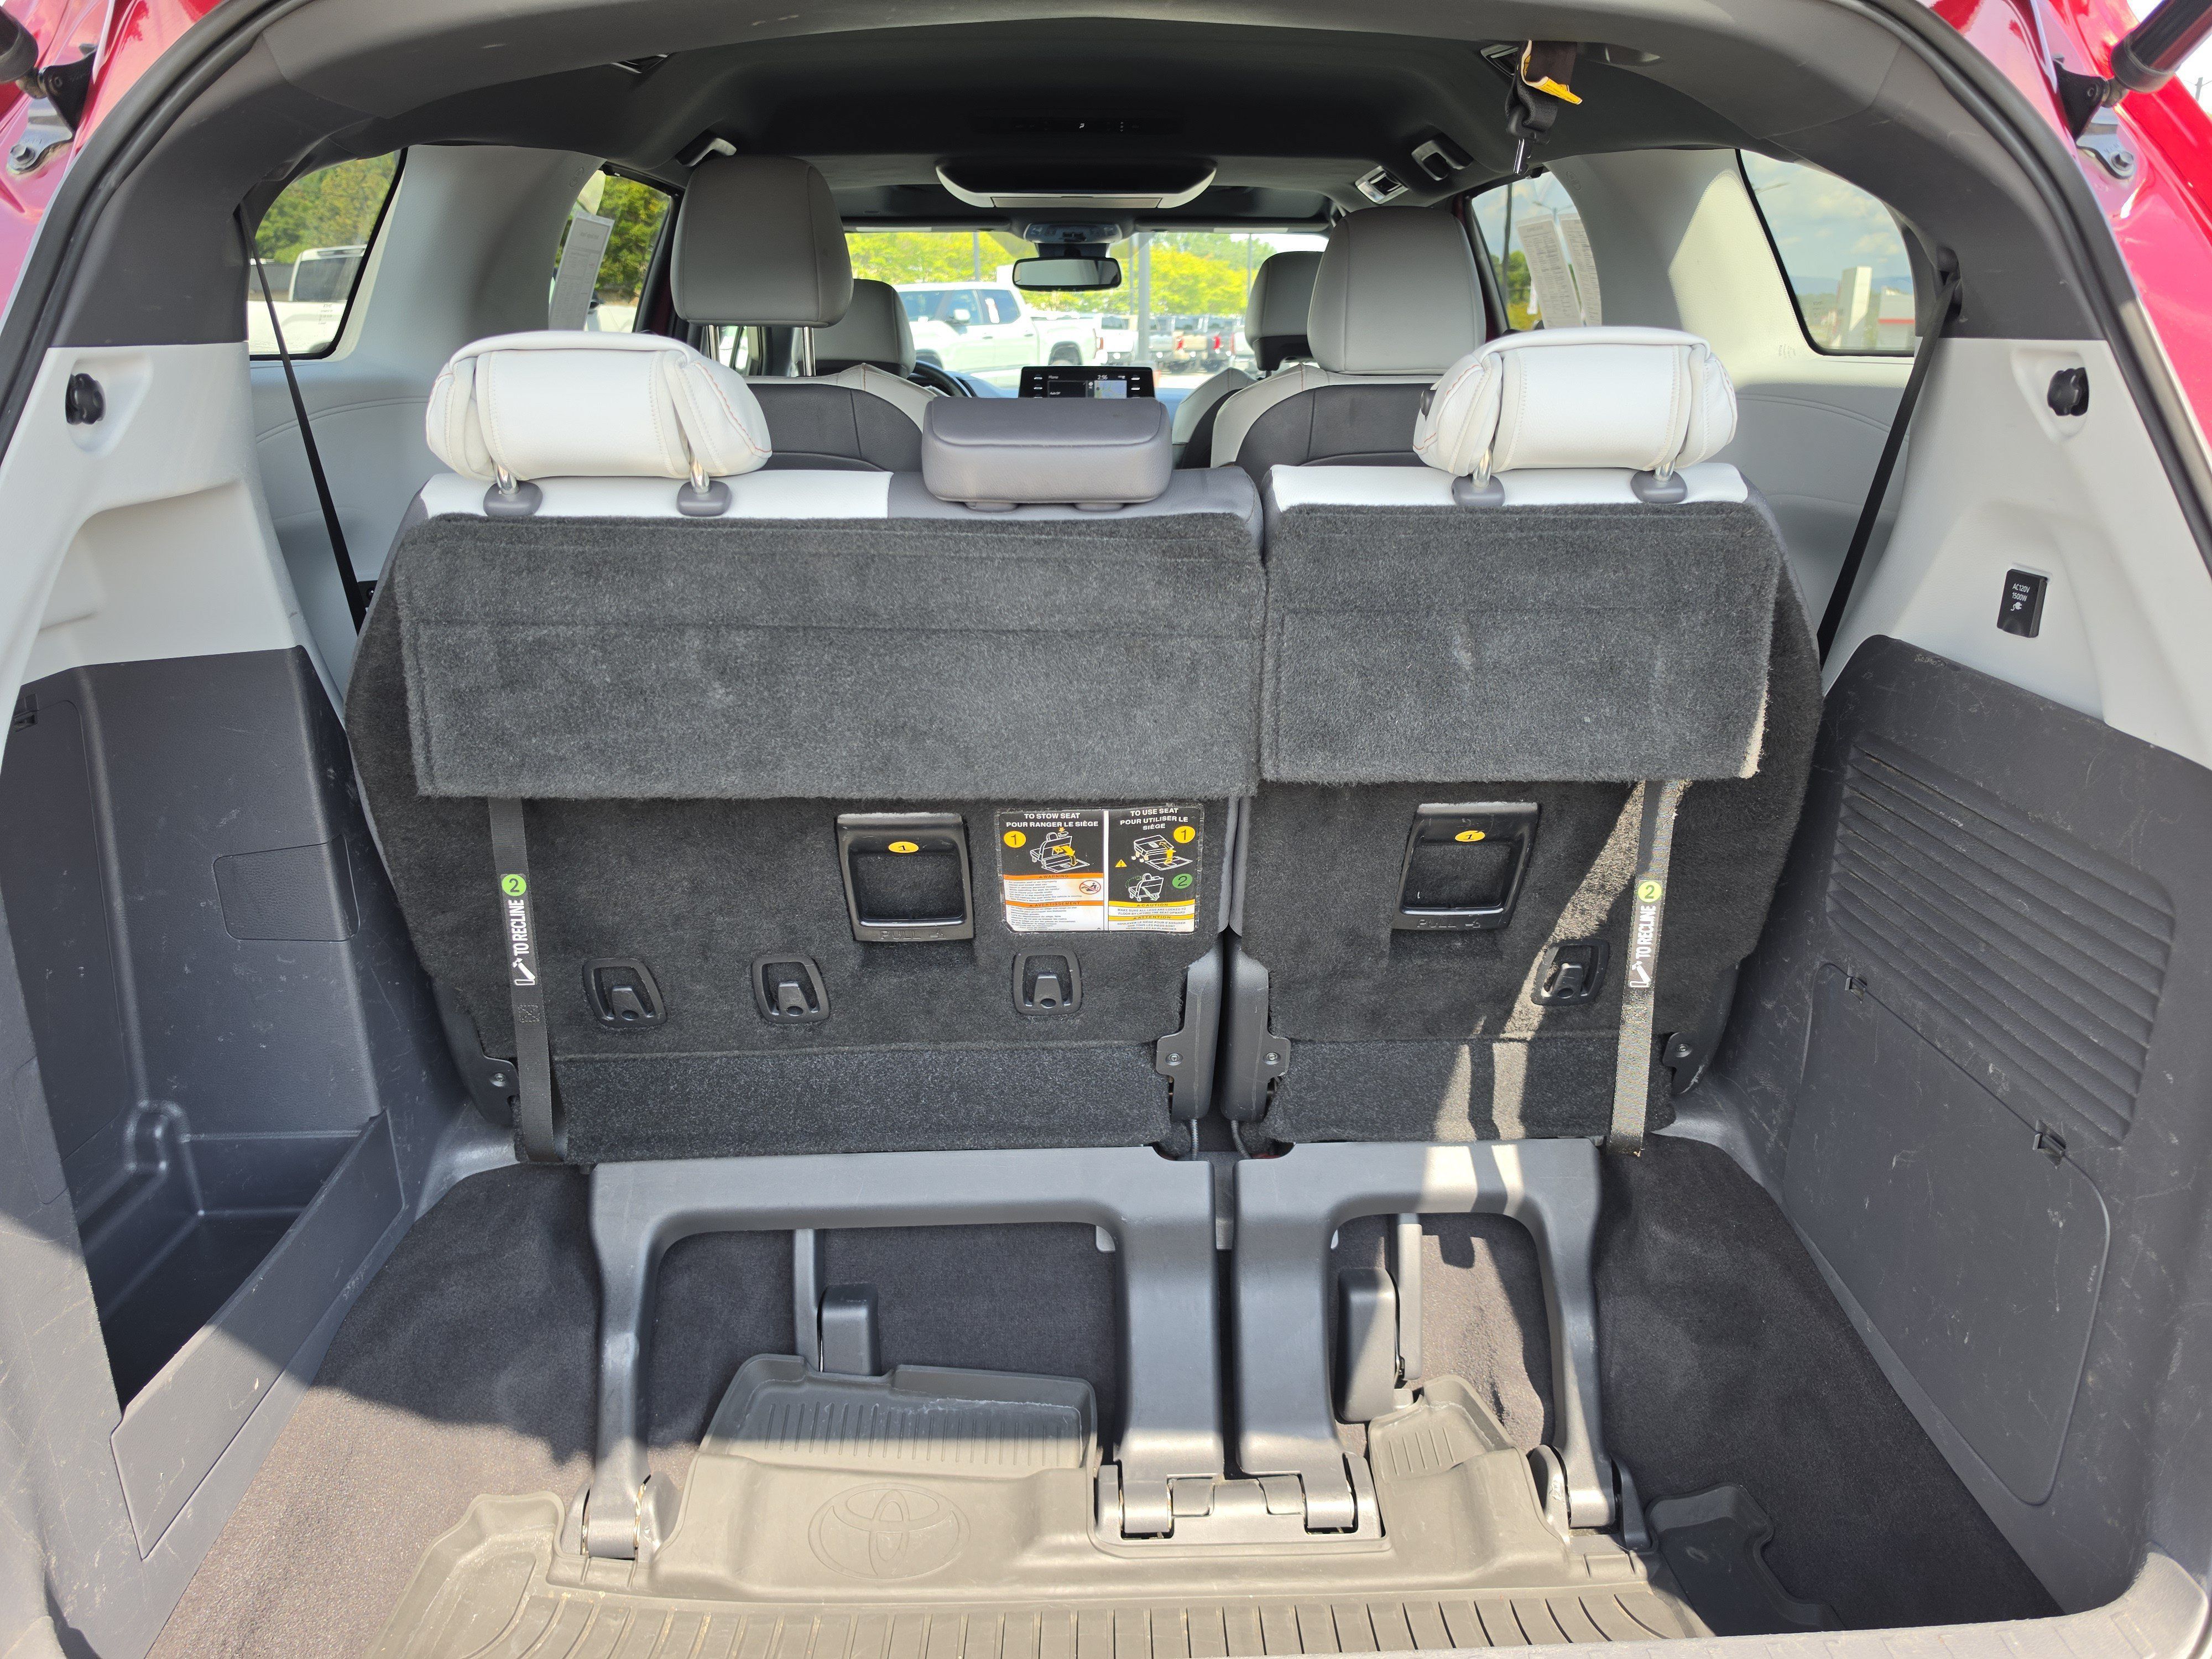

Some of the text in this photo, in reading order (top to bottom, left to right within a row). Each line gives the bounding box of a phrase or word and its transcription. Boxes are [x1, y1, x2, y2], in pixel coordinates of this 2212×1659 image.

[2012, 592, 2027, 602] 1500W
[1011, 834, 1017, 845] 1
[1181, 830, 1186, 840] 1
[509, 878, 520, 893] 2
[1178, 876, 1188, 886] 2
[1644, 885, 1655, 899] 2
[508, 899, 530, 956] TO RECLINE
[1636, 905, 1656, 959] TO RECLINE
[879, 930, 921, 940] PULL
